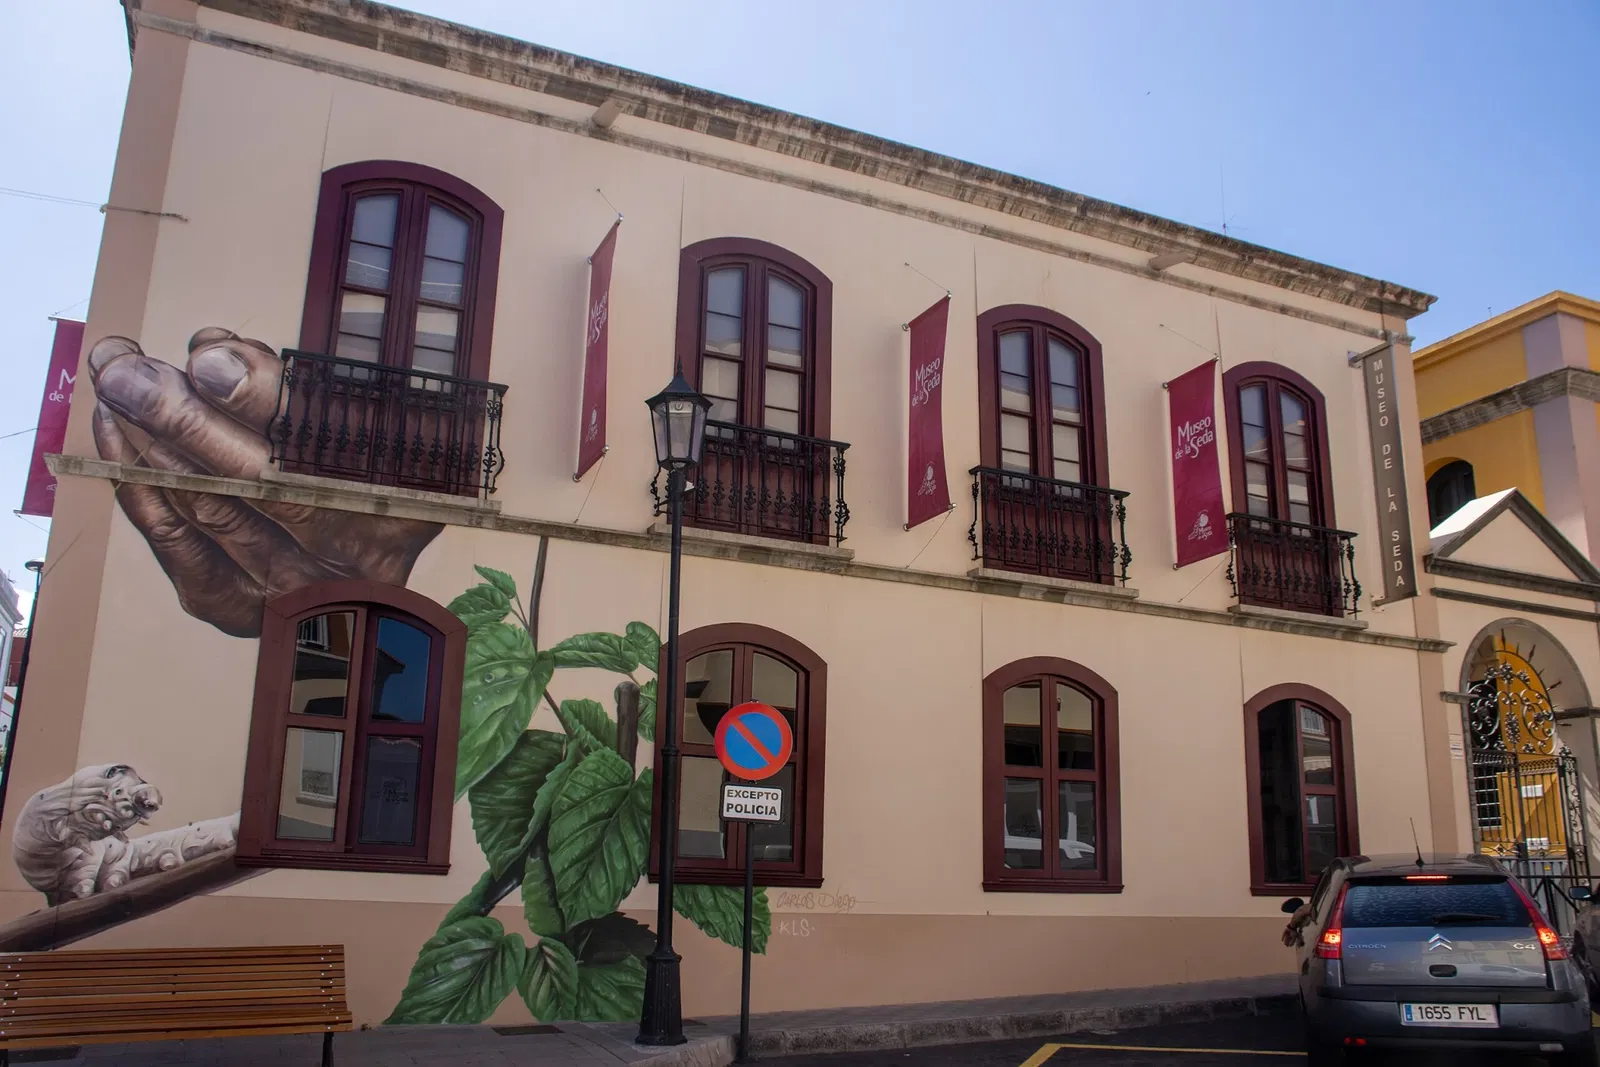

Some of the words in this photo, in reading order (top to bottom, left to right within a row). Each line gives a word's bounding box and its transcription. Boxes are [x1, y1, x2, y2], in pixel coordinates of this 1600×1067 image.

[915, 357, 941, 391] Museo
[49, 391, 64, 401] de
[922, 371, 941, 405] Seda
[1373, 359, 1389, 427] MUSEO
[1175, 448, 1183, 460] de
[1190, 429, 1213, 458] Seda
[1178, 416, 1212, 447] Museo
[1382, 443, 1393, 470] DE
[1387, 487, 1398, 513] LA
[1391, 530, 1405, 587] SEDA
[727, 789, 779, 801] EXCEPTO
[726, 803, 777, 816] POLICIA
[1513, 942, 1536, 950] C4
[1418, 1006, 1451, 1020] 1655
[1458, 1006, 1487, 1021] FYL
